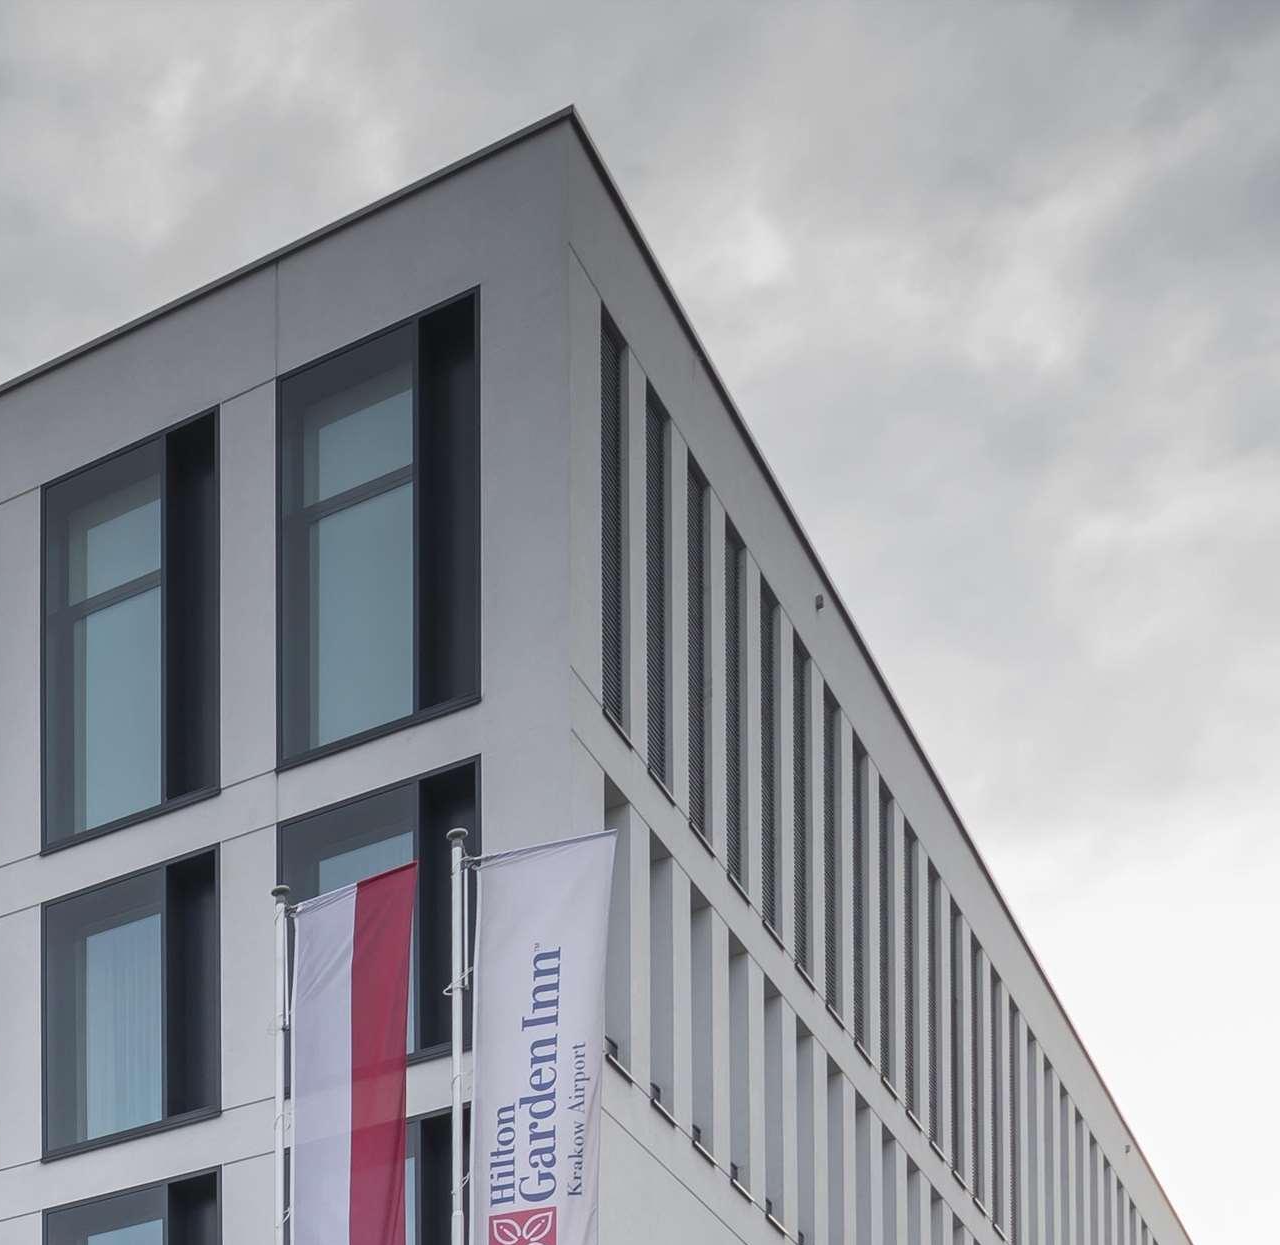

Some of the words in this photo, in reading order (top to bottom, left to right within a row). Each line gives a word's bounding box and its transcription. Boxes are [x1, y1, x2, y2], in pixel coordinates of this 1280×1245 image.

[518, 1033, 558, 1203] Garden
[567, 1041, 591, 1114] Airport
[489, 1102, 517, 1208] Hilton
[566, 1120, 586, 1197] Krakow
